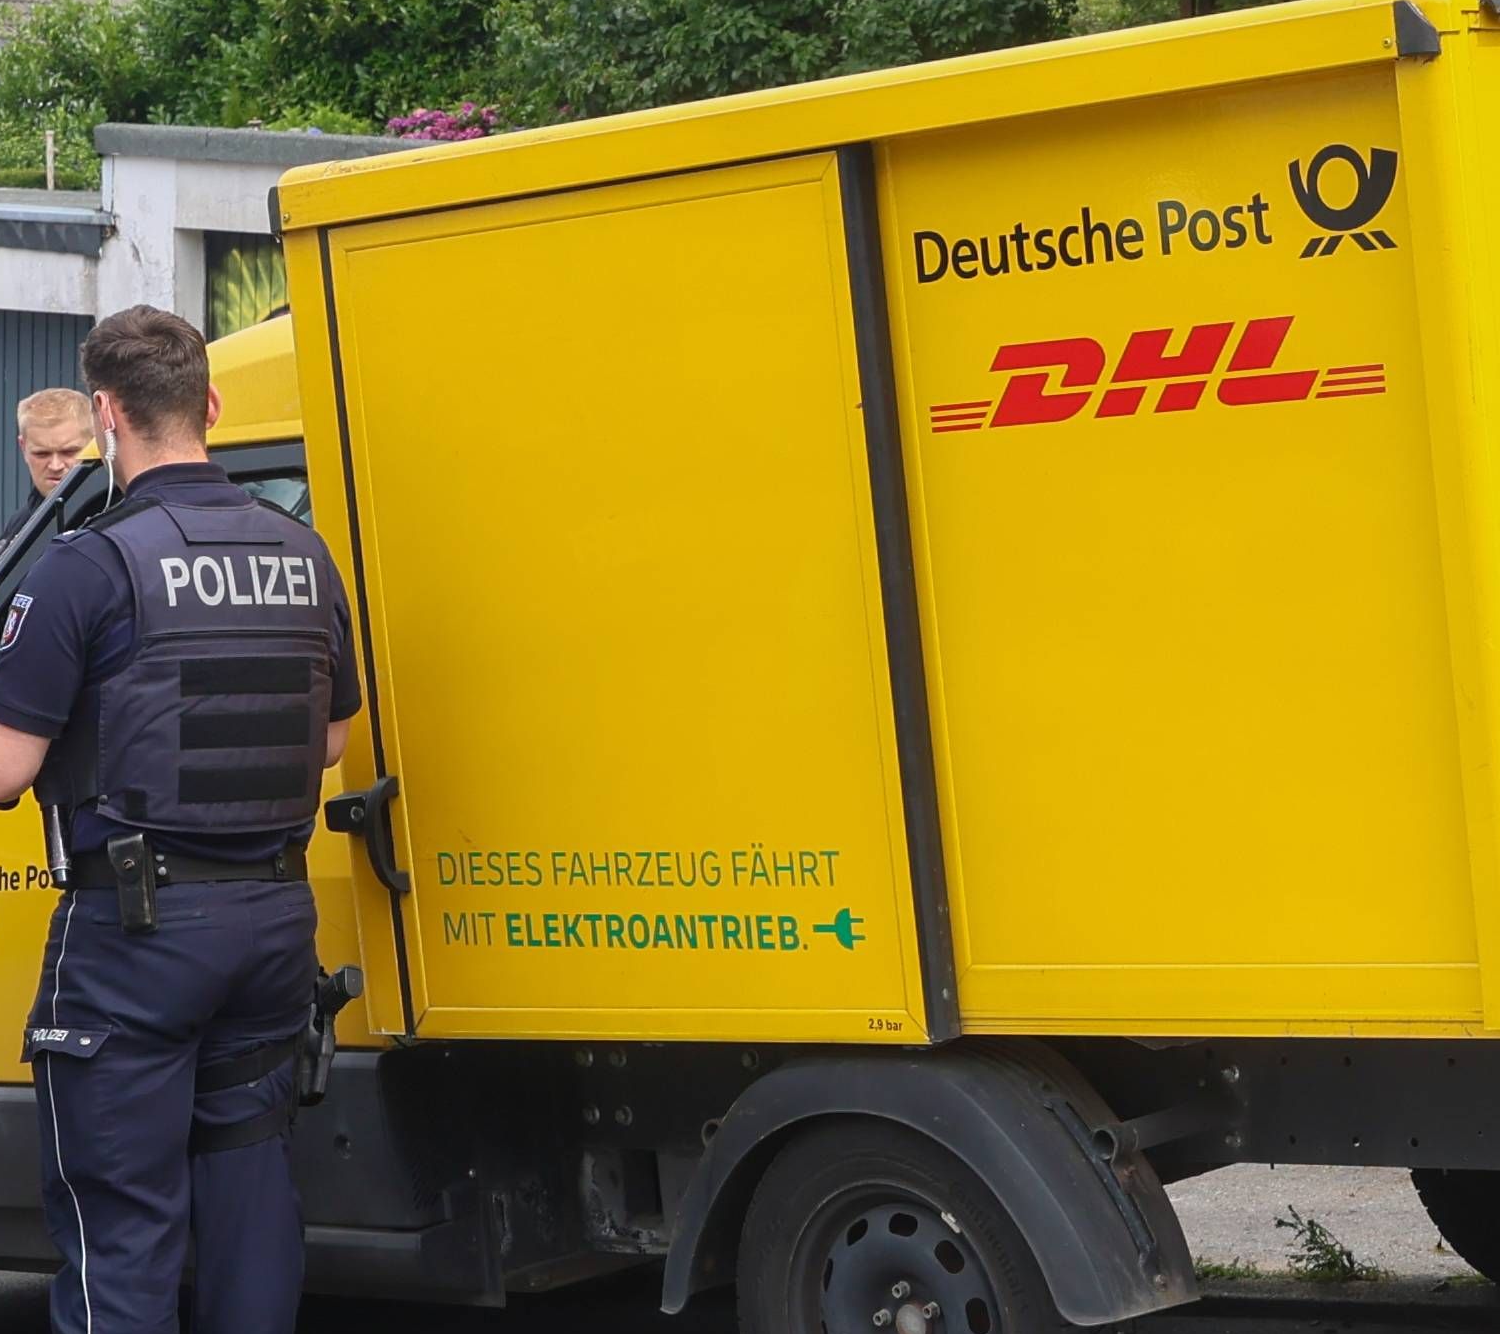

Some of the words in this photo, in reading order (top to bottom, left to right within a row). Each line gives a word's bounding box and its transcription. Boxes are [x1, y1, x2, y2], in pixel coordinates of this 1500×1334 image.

[913, 207, 1144, 284] Deutsche
[1157, 193, 1273, 256] Post
[988, 315, 1320, 429] DHL
[159, 555, 318, 607] POLIZEI
[25, 865, 53, 890] Po
[437, 851, 542, 886] DIESES
[551, 851, 723, 887] FAHRZEUG
[731, 843, 839, 888] FÄHRT
[443, 912, 496, 946] MIT
[505, 913, 809, 952] ELEKTROANTRIEB.
[31, 1028, 69, 1043] POLIZEI
[868, 1018, 884, 1032] 2,9
[886, 1019, 903, 1032] bar
